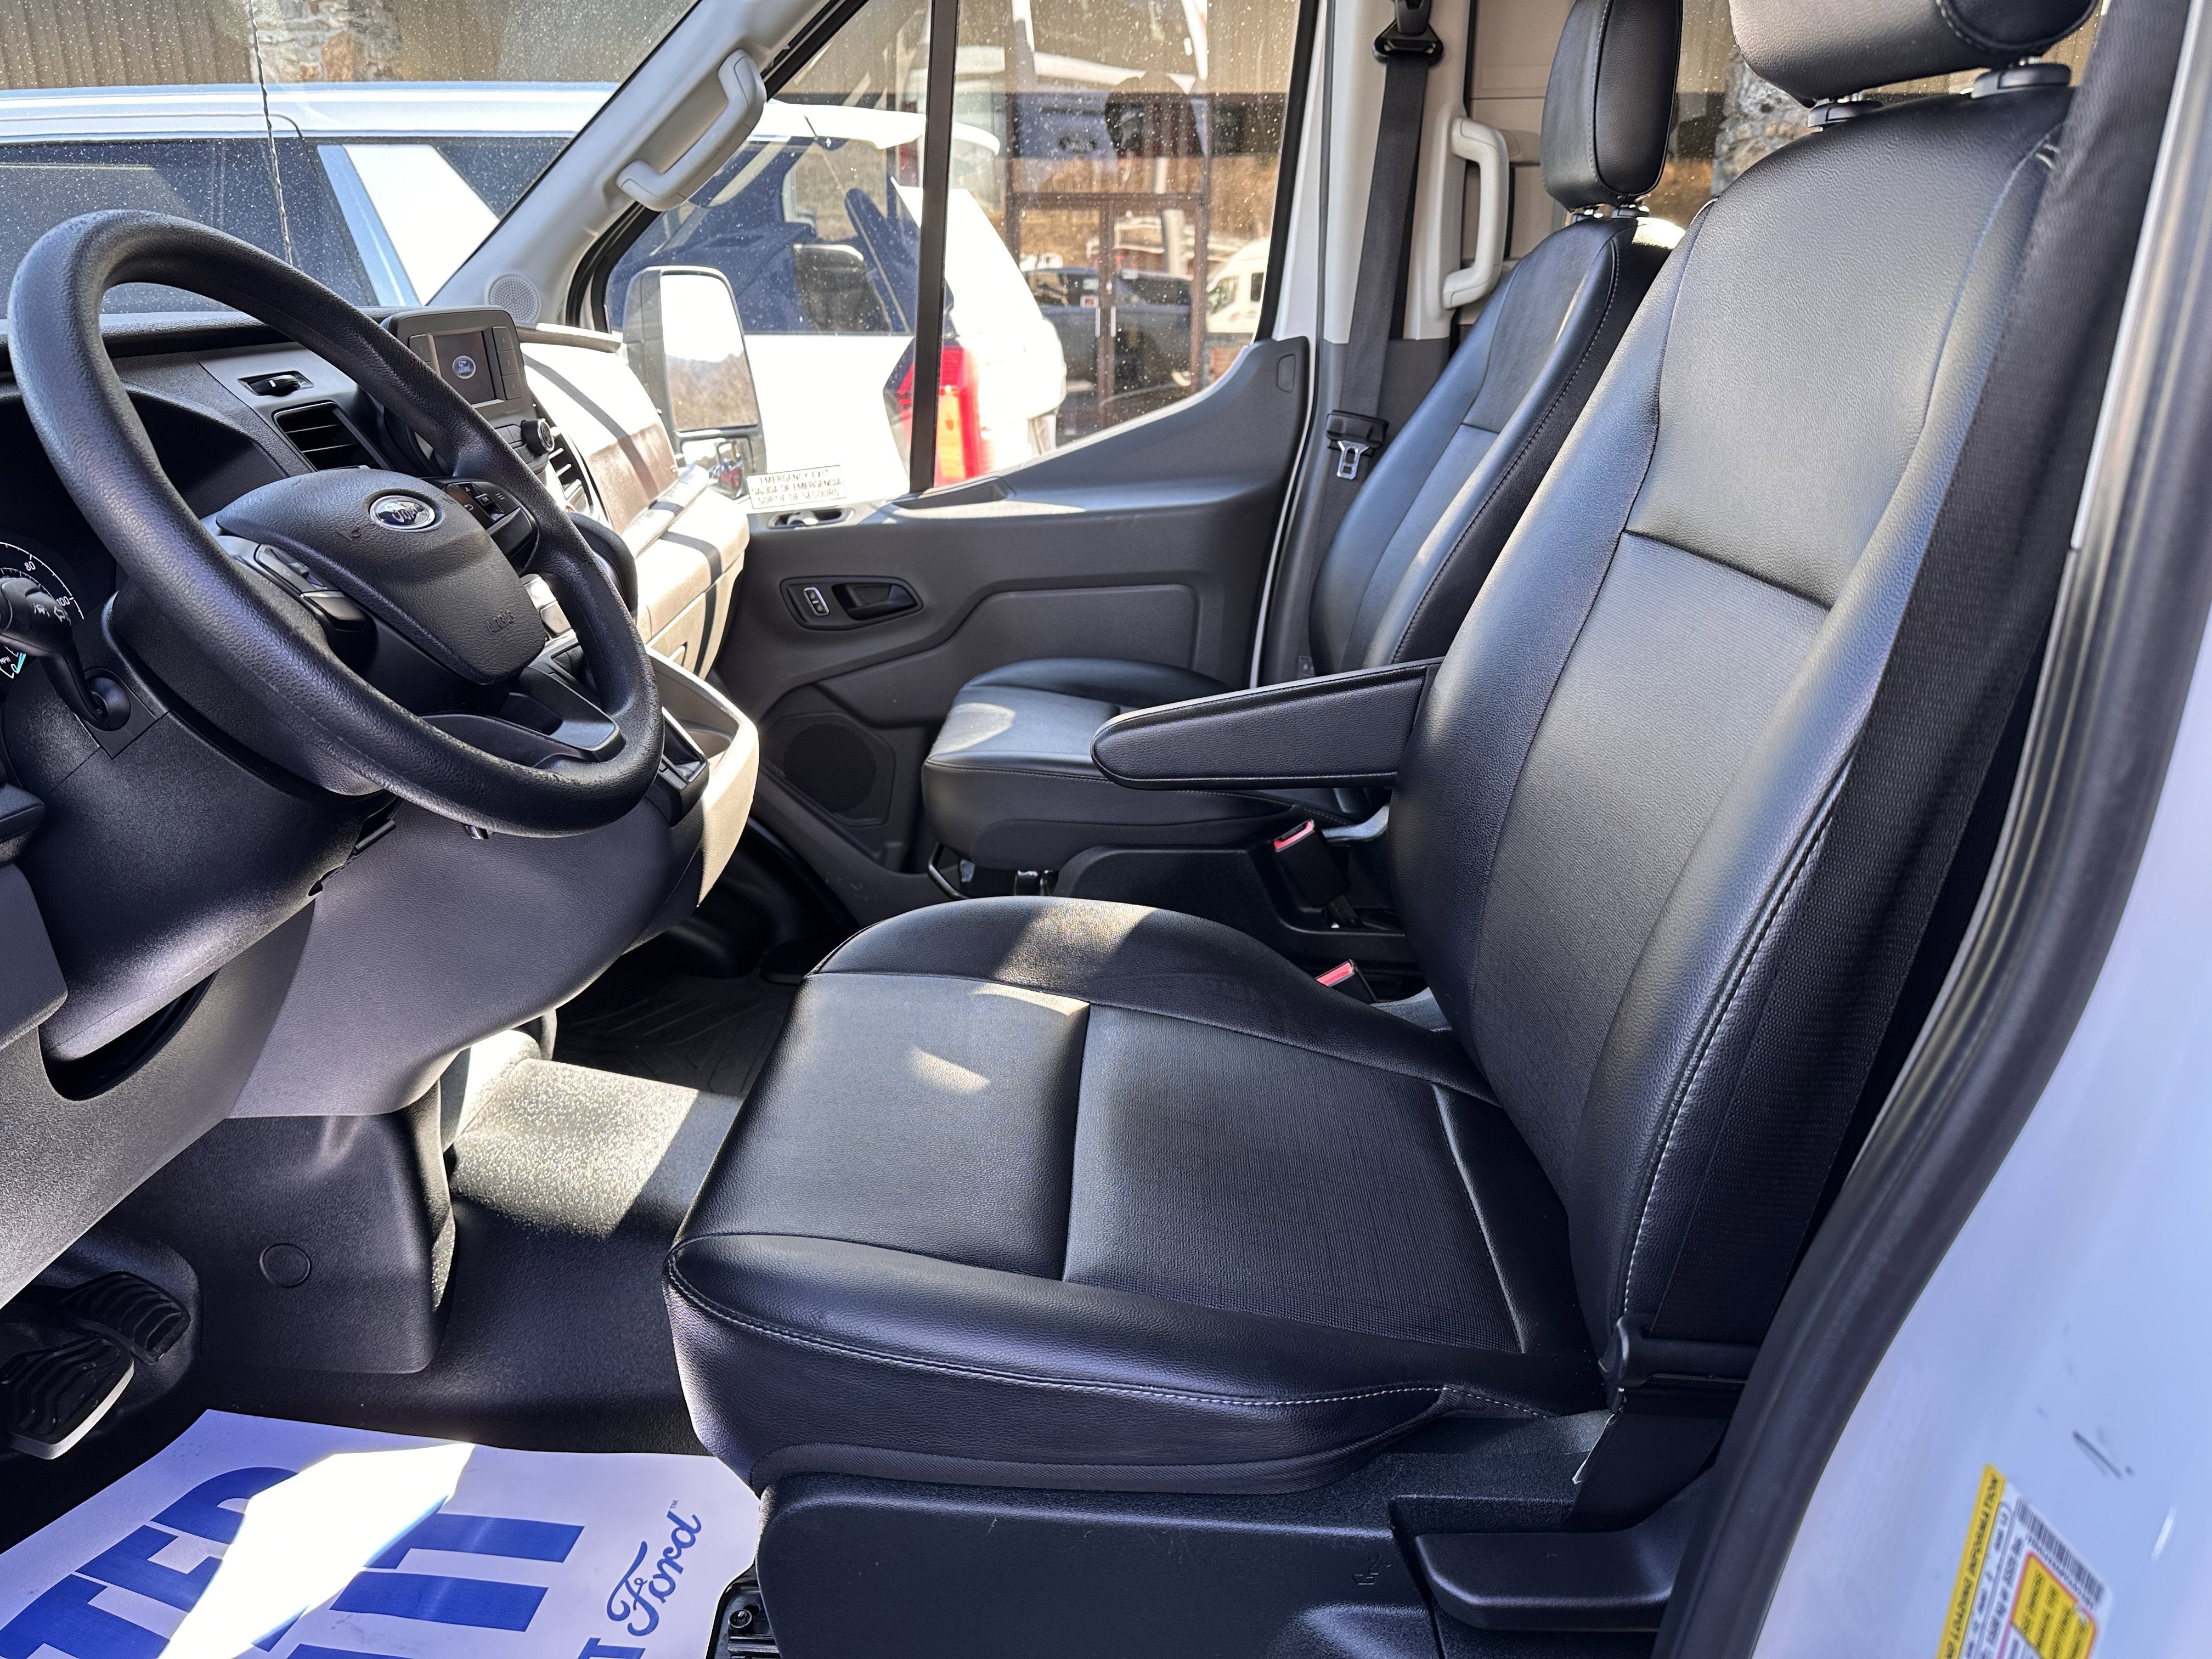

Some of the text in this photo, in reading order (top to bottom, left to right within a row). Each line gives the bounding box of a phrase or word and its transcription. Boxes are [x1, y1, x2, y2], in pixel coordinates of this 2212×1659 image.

[760, 470, 828, 484] EMERGENCY EXIT
[759, 488, 839, 505] SORTIE DE SECOURS
[24, 561, 36, 571] 80
[56, 596, 70, 606] 100
[606, 1510, 702, 1637] Ford
